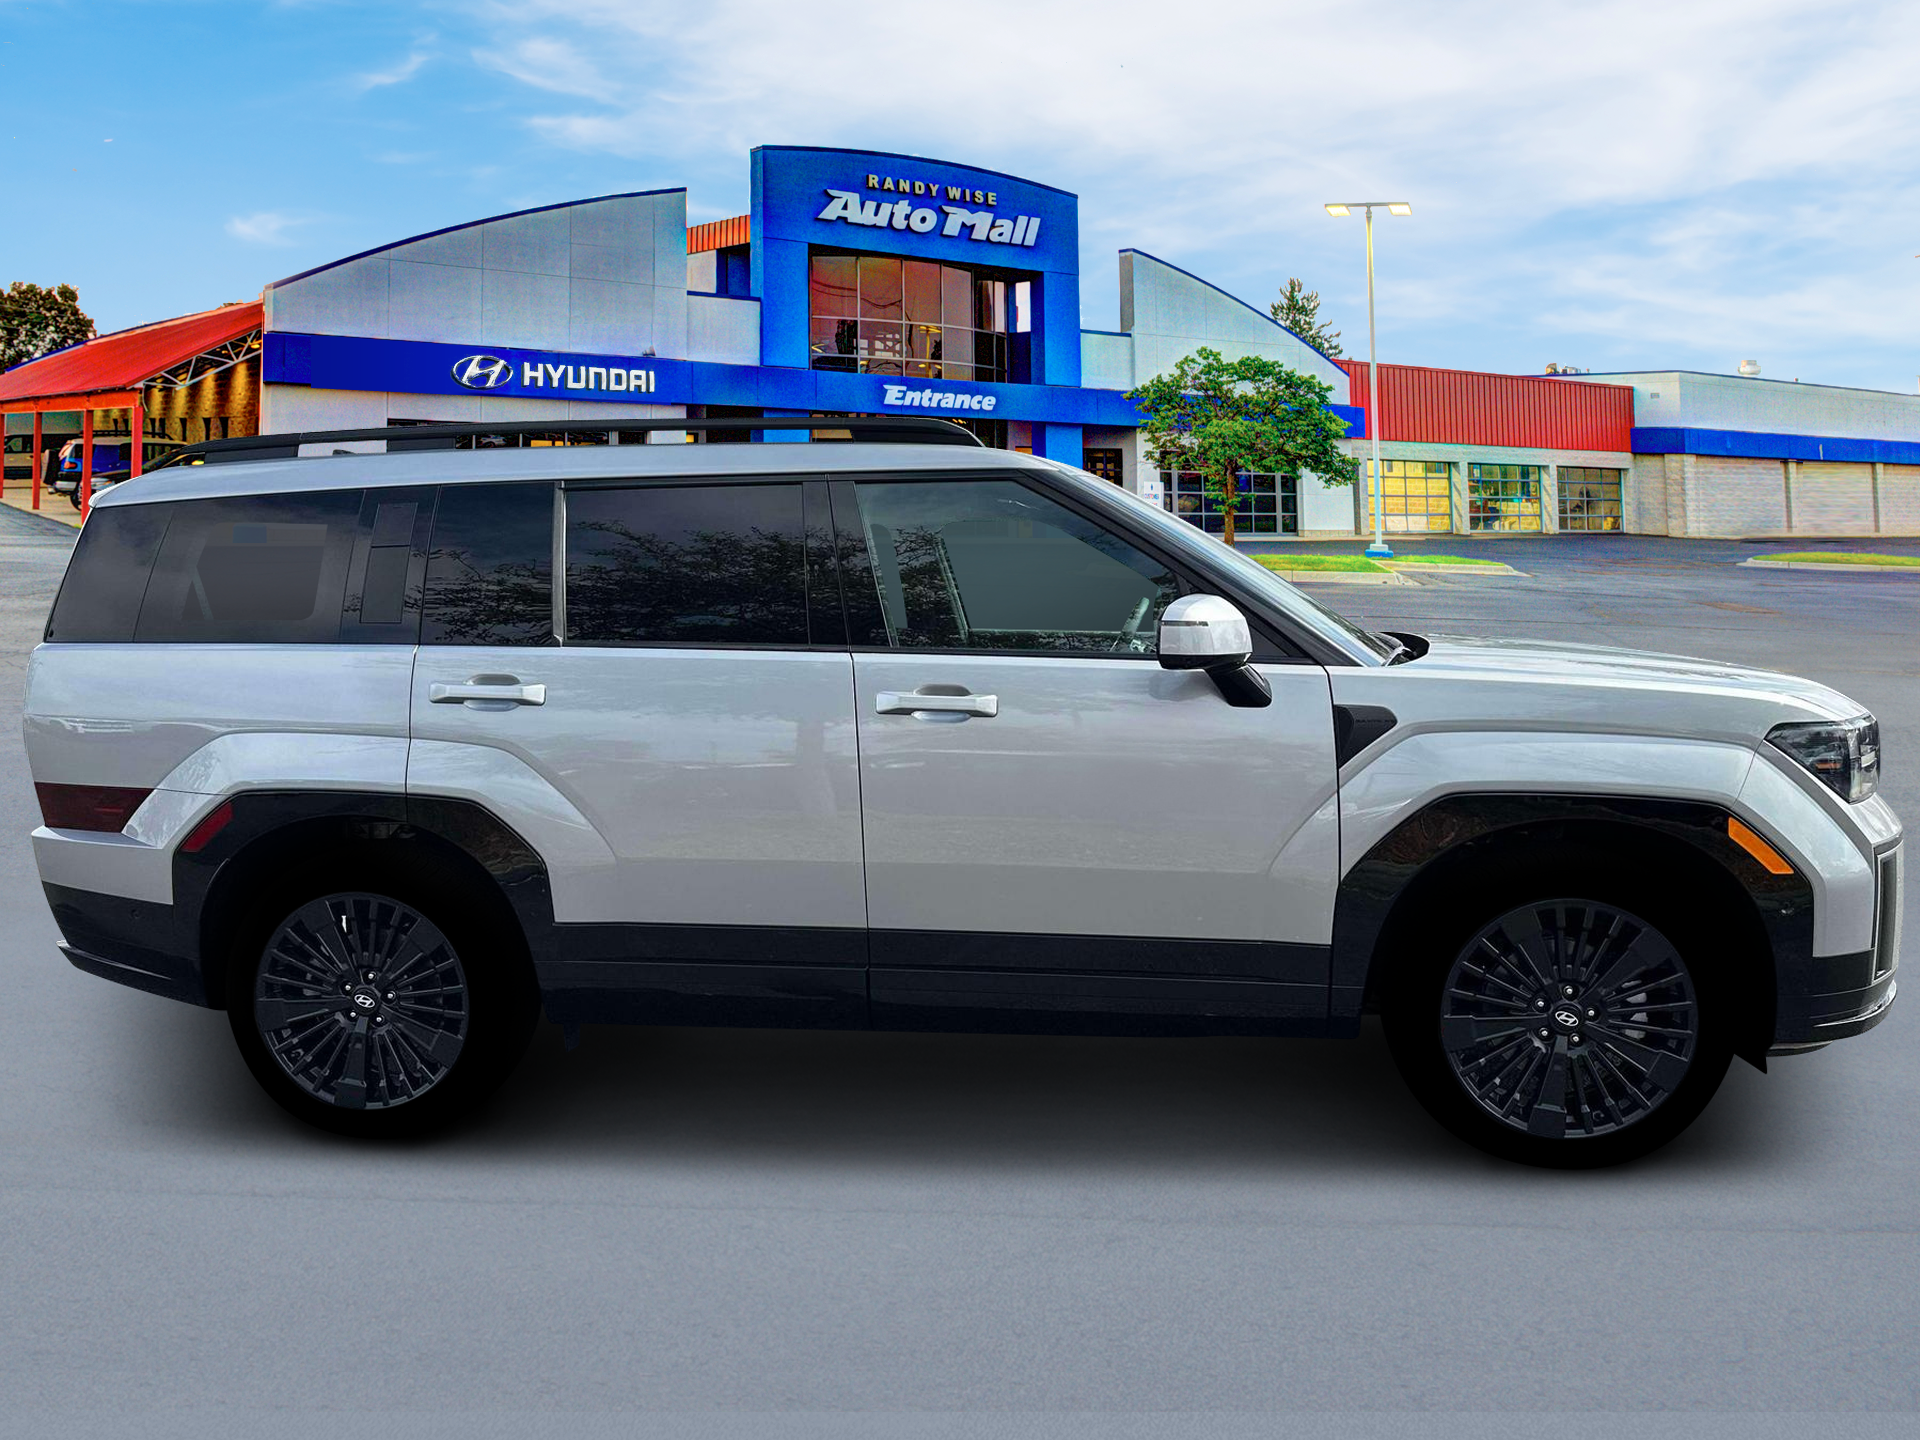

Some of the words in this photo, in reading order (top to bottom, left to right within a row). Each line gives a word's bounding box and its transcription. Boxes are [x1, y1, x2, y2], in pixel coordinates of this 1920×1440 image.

[867, 173, 939, 197] RANDY
[946, 186, 997, 206] WISE
[816, 188, 938, 233] Auto
[941, 205, 1041, 247] Mall
[522, 362, 656, 393] HYUNDAI
[883, 384, 997, 411] Entrance
